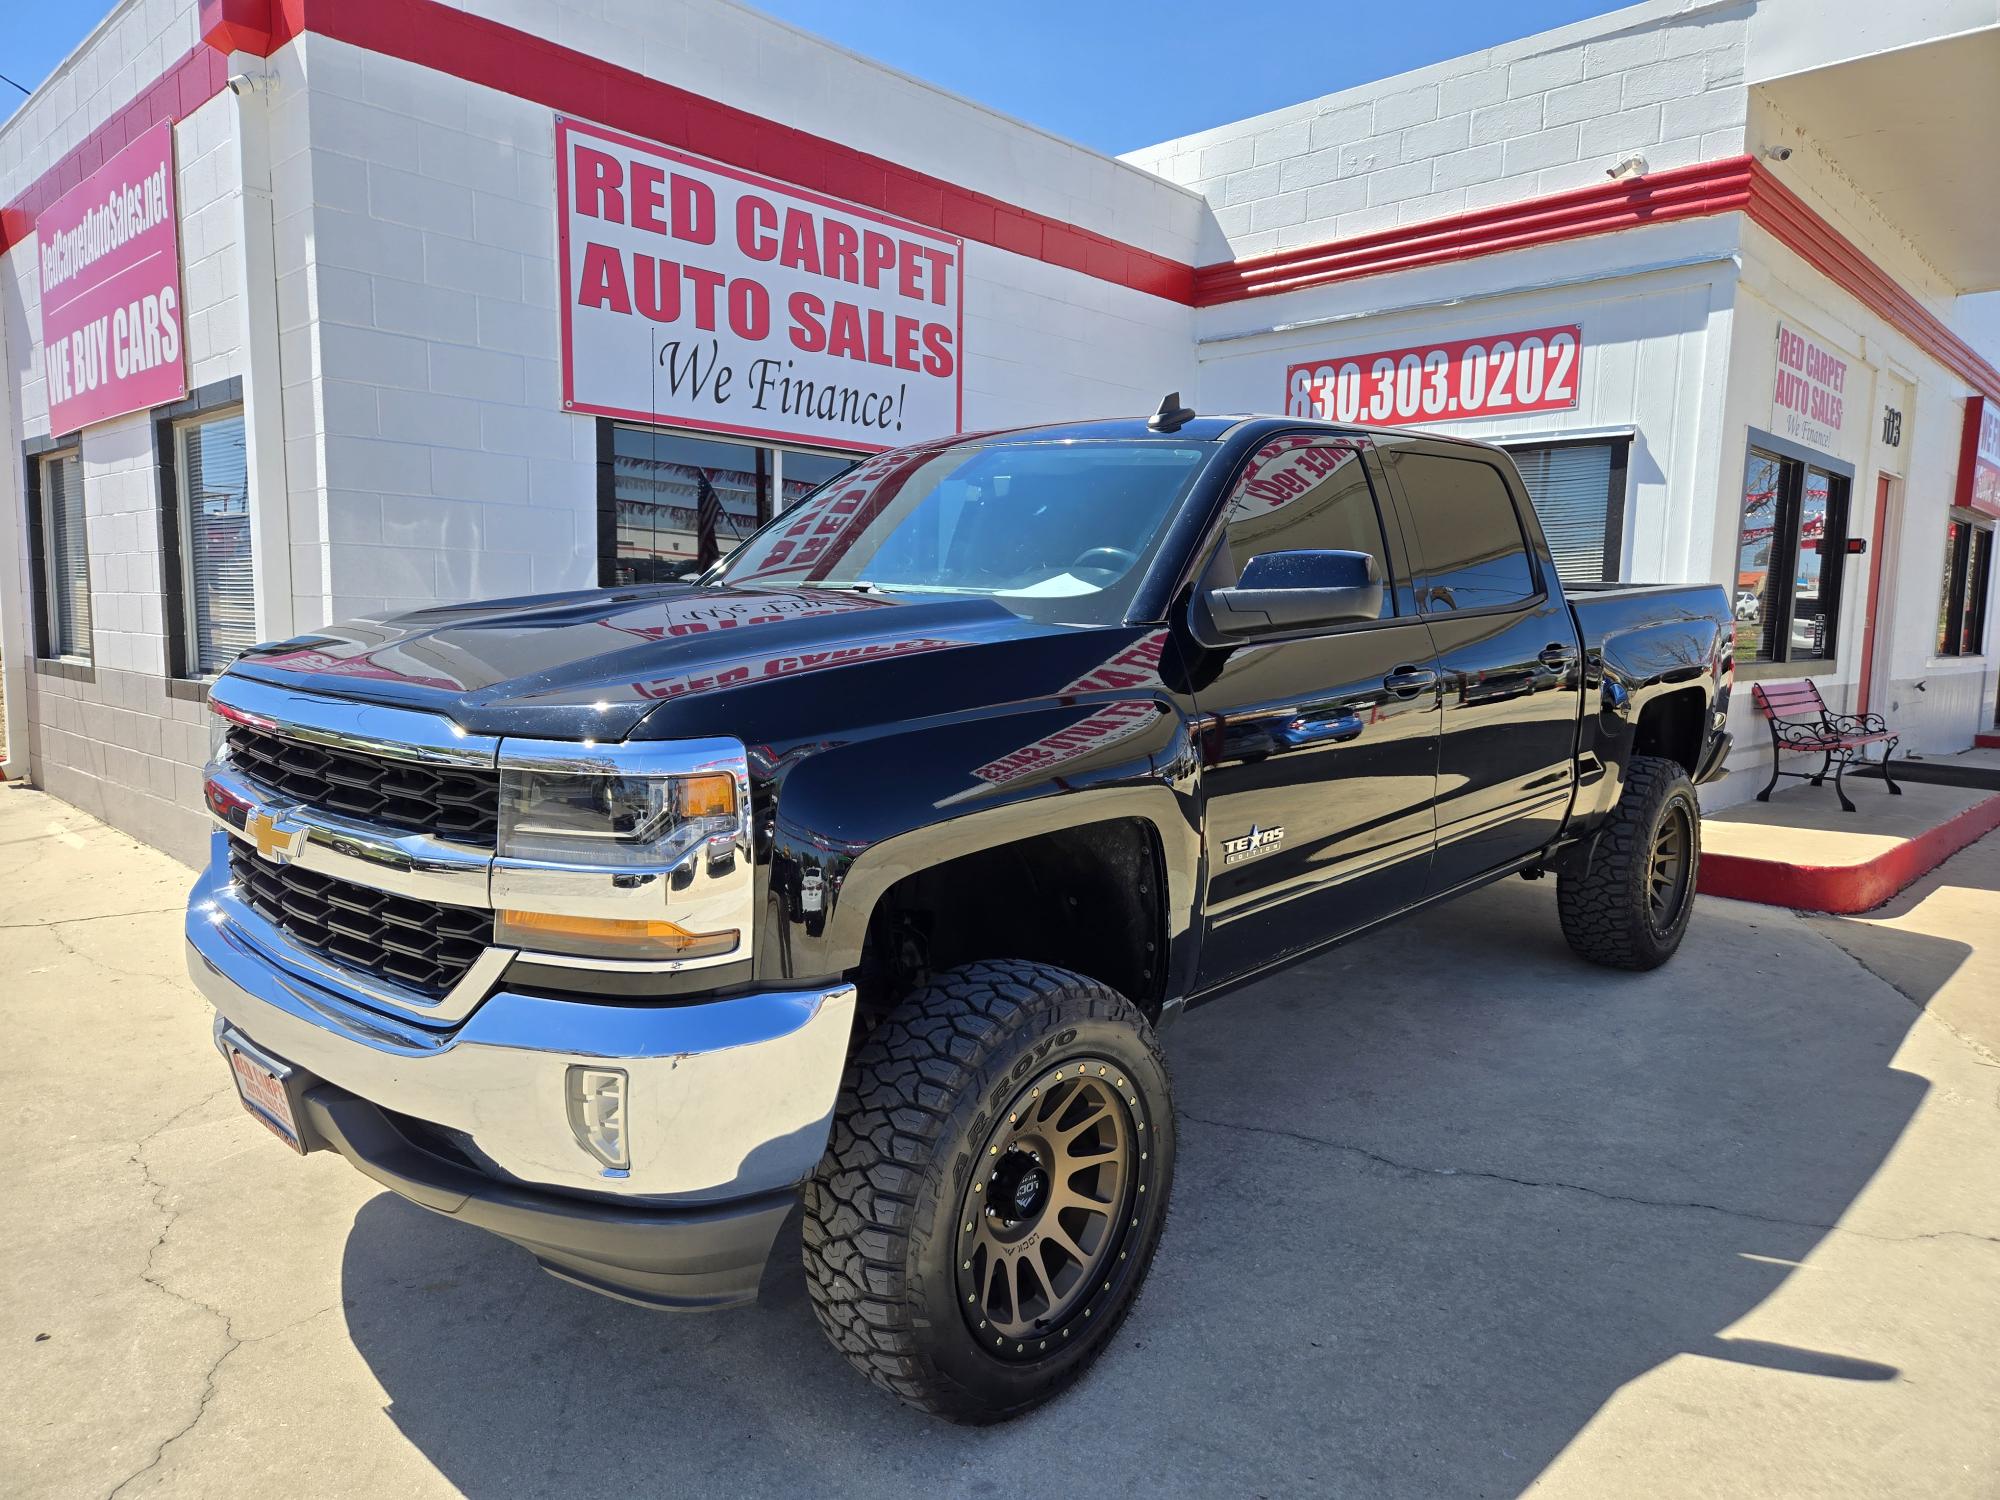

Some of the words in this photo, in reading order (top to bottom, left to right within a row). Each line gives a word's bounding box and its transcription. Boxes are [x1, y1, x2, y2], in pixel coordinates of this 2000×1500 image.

[41, 160, 169, 294] RedCarpetAutoSales.net
[573, 143, 716, 247] RED
[735, 194, 954, 307] CARPET
[46, 335, 72, 407] WE
[72, 315, 109, 396] BUY
[113, 285, 179, 380] CARS
[577, 240, 770, 342] AUTO
[787, 290, 954, 379] SALES
[658, 338, 732, 405] We
[747, 358, 906, 432] Finance!
[1288, 332, 1576, 423] 830.303.0202
[1775, 367, 1810, 416] AUTO
[1810, 385, 1843, 431] SALES
[1778, 327, 1805, 372] RED
[1806, 343, 1847, 394] CARPET
[1786, 413, 1800, 437] We
[1801, 419, 1832, 449] Finance!
[1224, 824, 1285, 853] TEXAS
